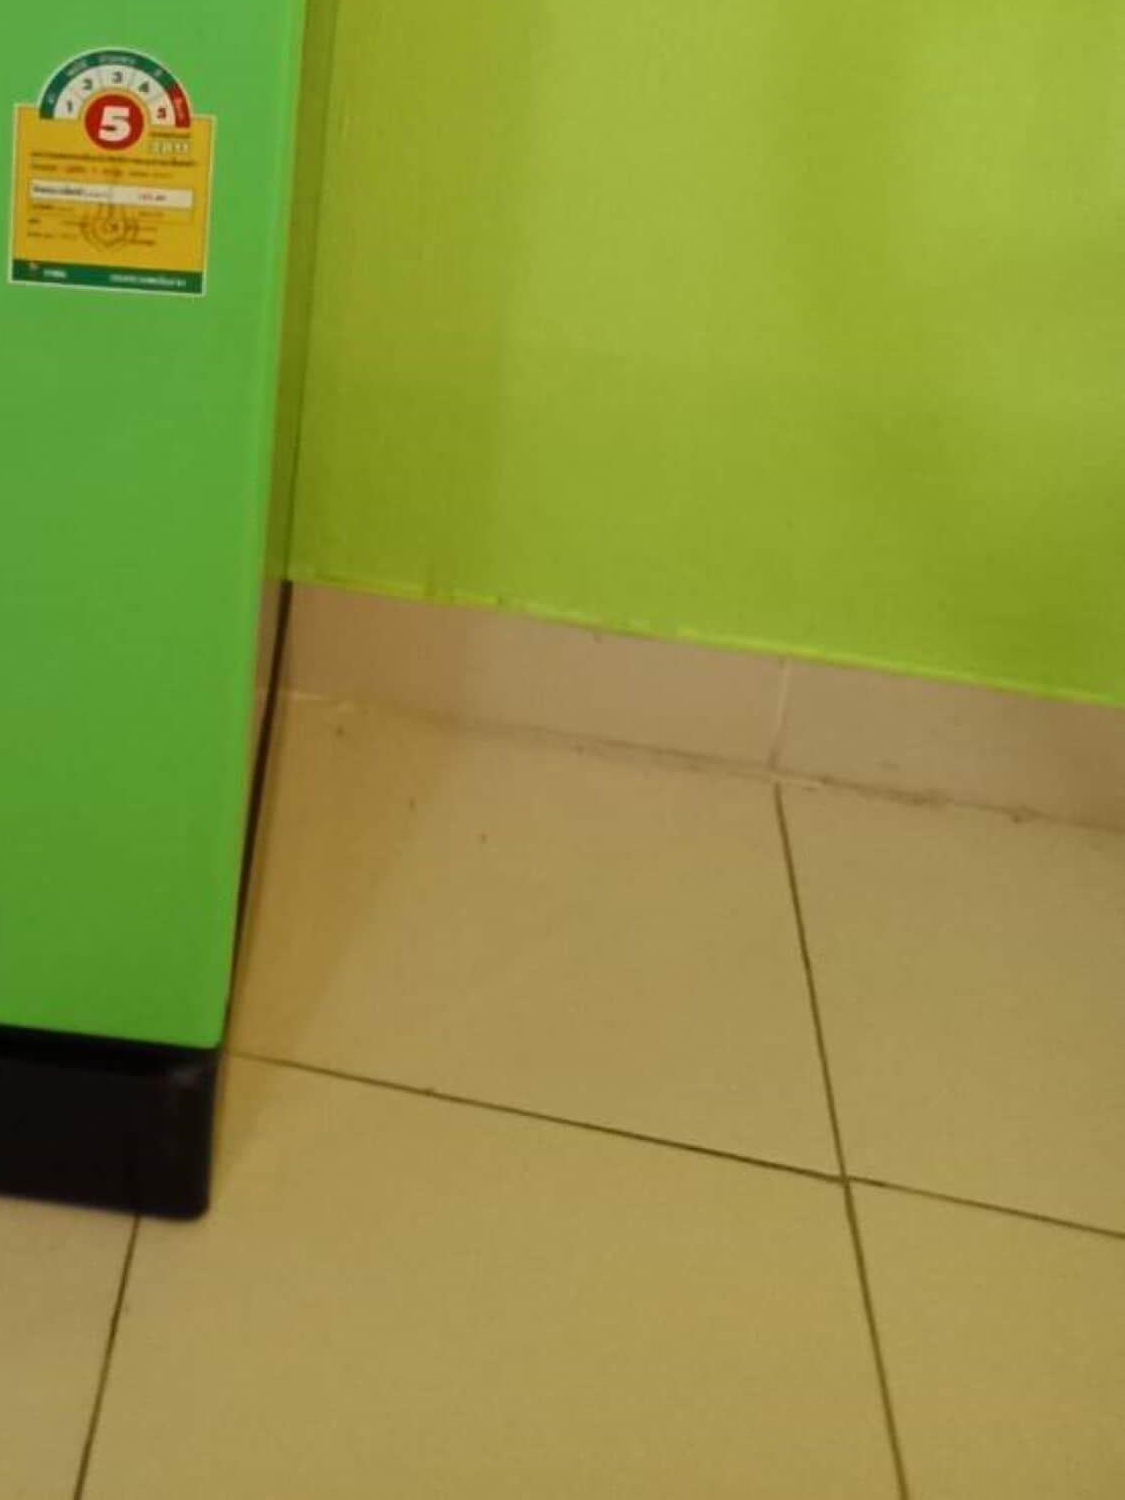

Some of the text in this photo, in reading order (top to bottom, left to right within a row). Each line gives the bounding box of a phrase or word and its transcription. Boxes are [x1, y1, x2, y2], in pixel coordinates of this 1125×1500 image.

[65, 101, 74, 114] 1
[82, 78, 94, 91] 2
[111, 70, 124, 83] 3
[138, 80, 150, 93] 4
[97, 105, 133, 142] 5
